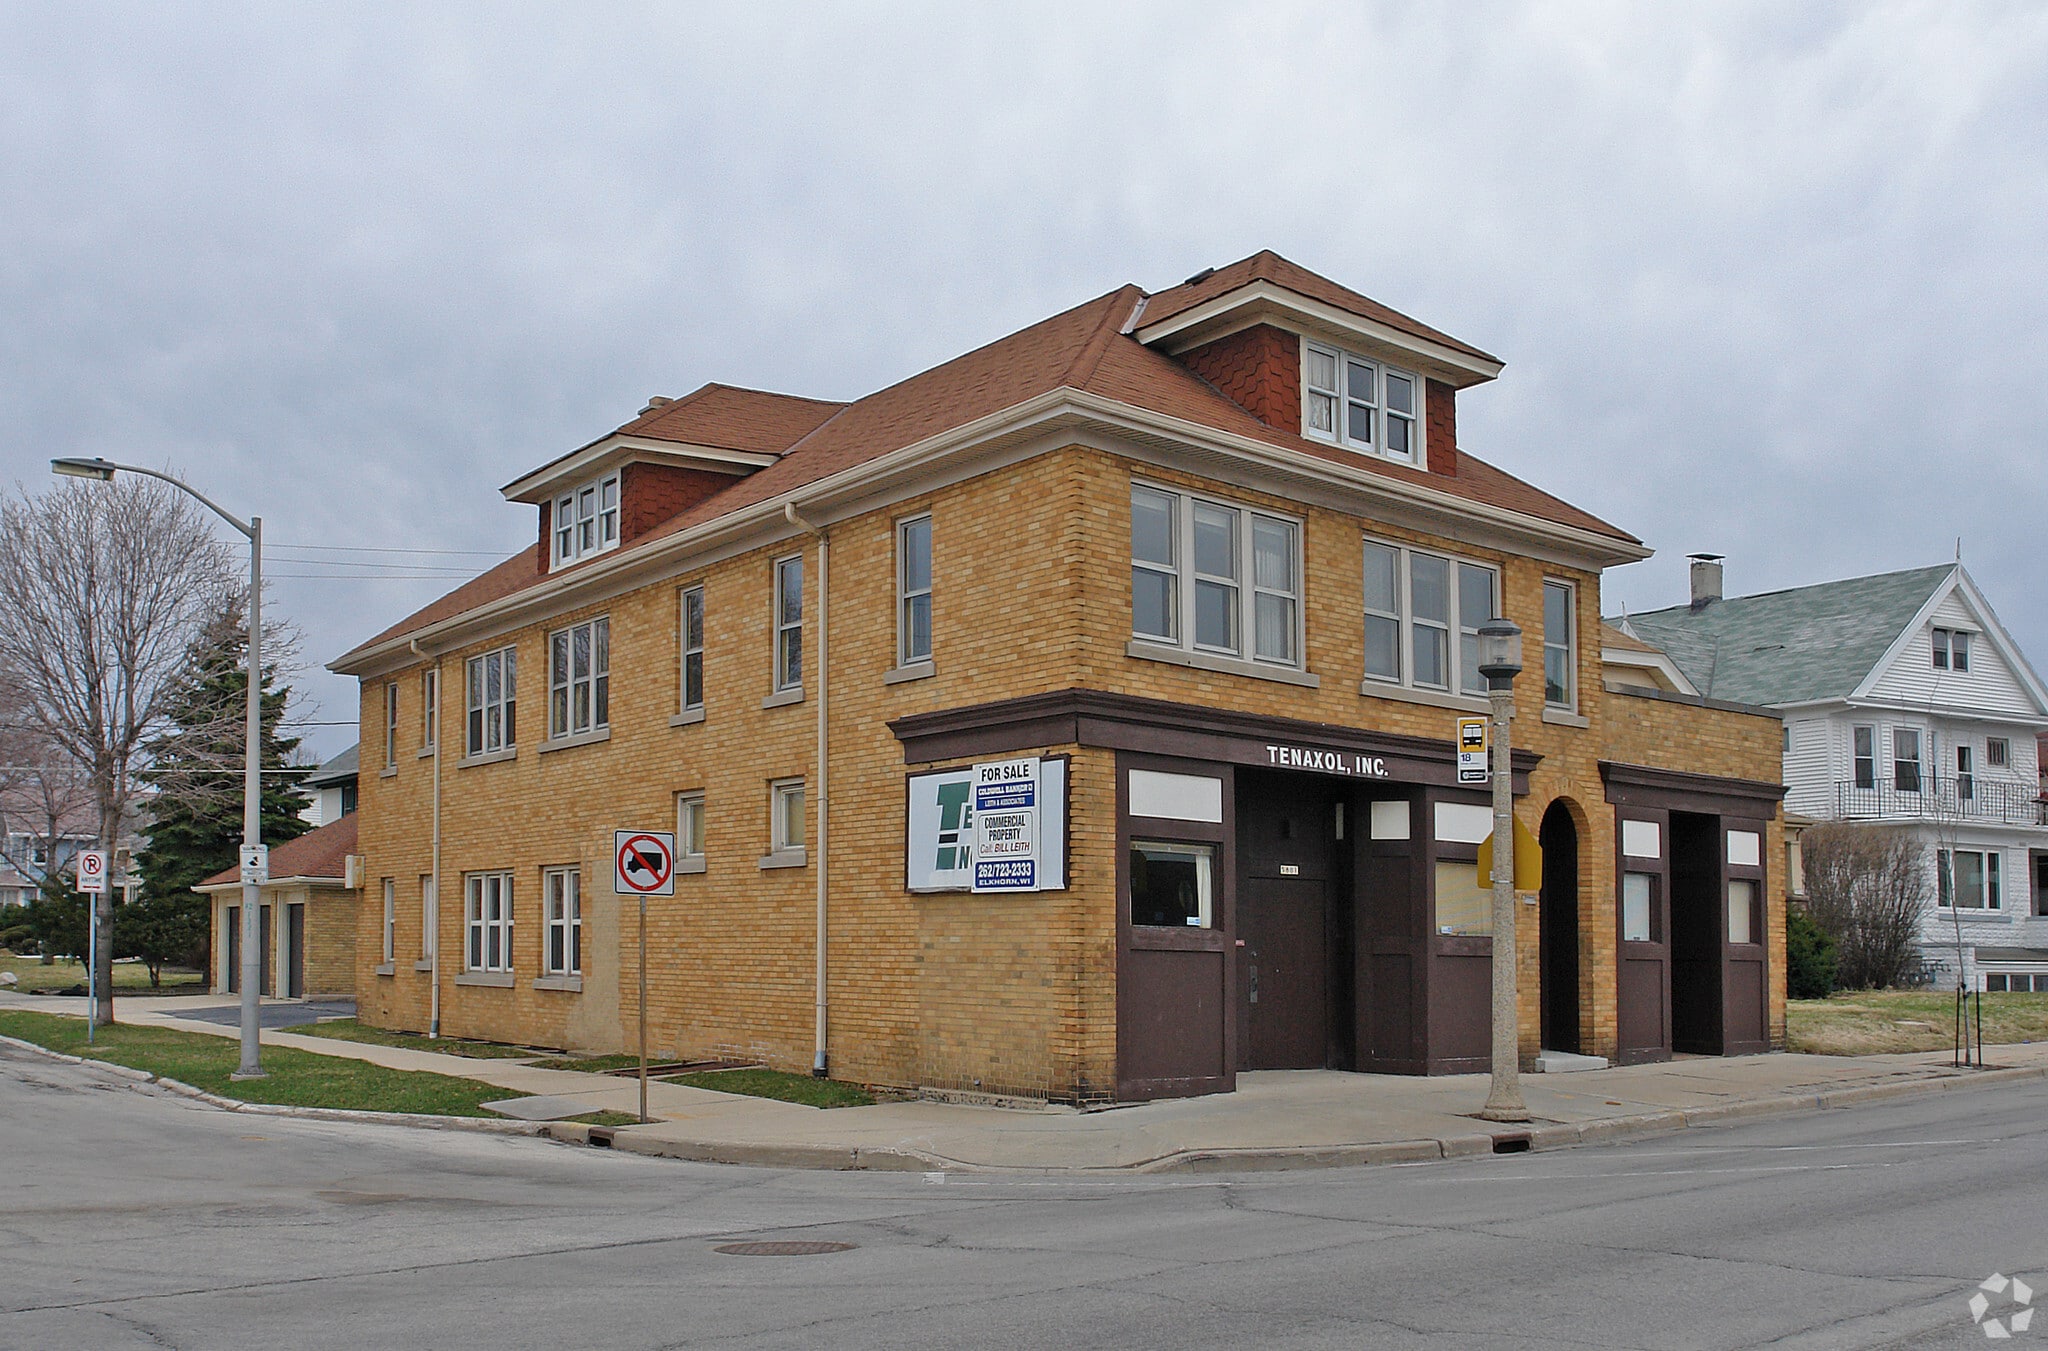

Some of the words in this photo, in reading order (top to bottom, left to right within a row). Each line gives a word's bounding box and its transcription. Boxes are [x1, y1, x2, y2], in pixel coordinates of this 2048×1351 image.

[1266, 745, 1351, 775] TENAXOL,
[1355, 756, 1389, 777] INC.
[1460, 753, 1471, 762] 18
[981, 768, 1001, 782] FOR
[1003, 764, 1030, 780] SALE
[984, 814, 1026, 829] COMMERCIAL
[988, 828, 1021, 841] PROPERTY
[994, 842, 1009, 853] BILL
[1010, 841, 1030, 852] LEITH
[978, 862, 1032, 878] 262/723-2333
